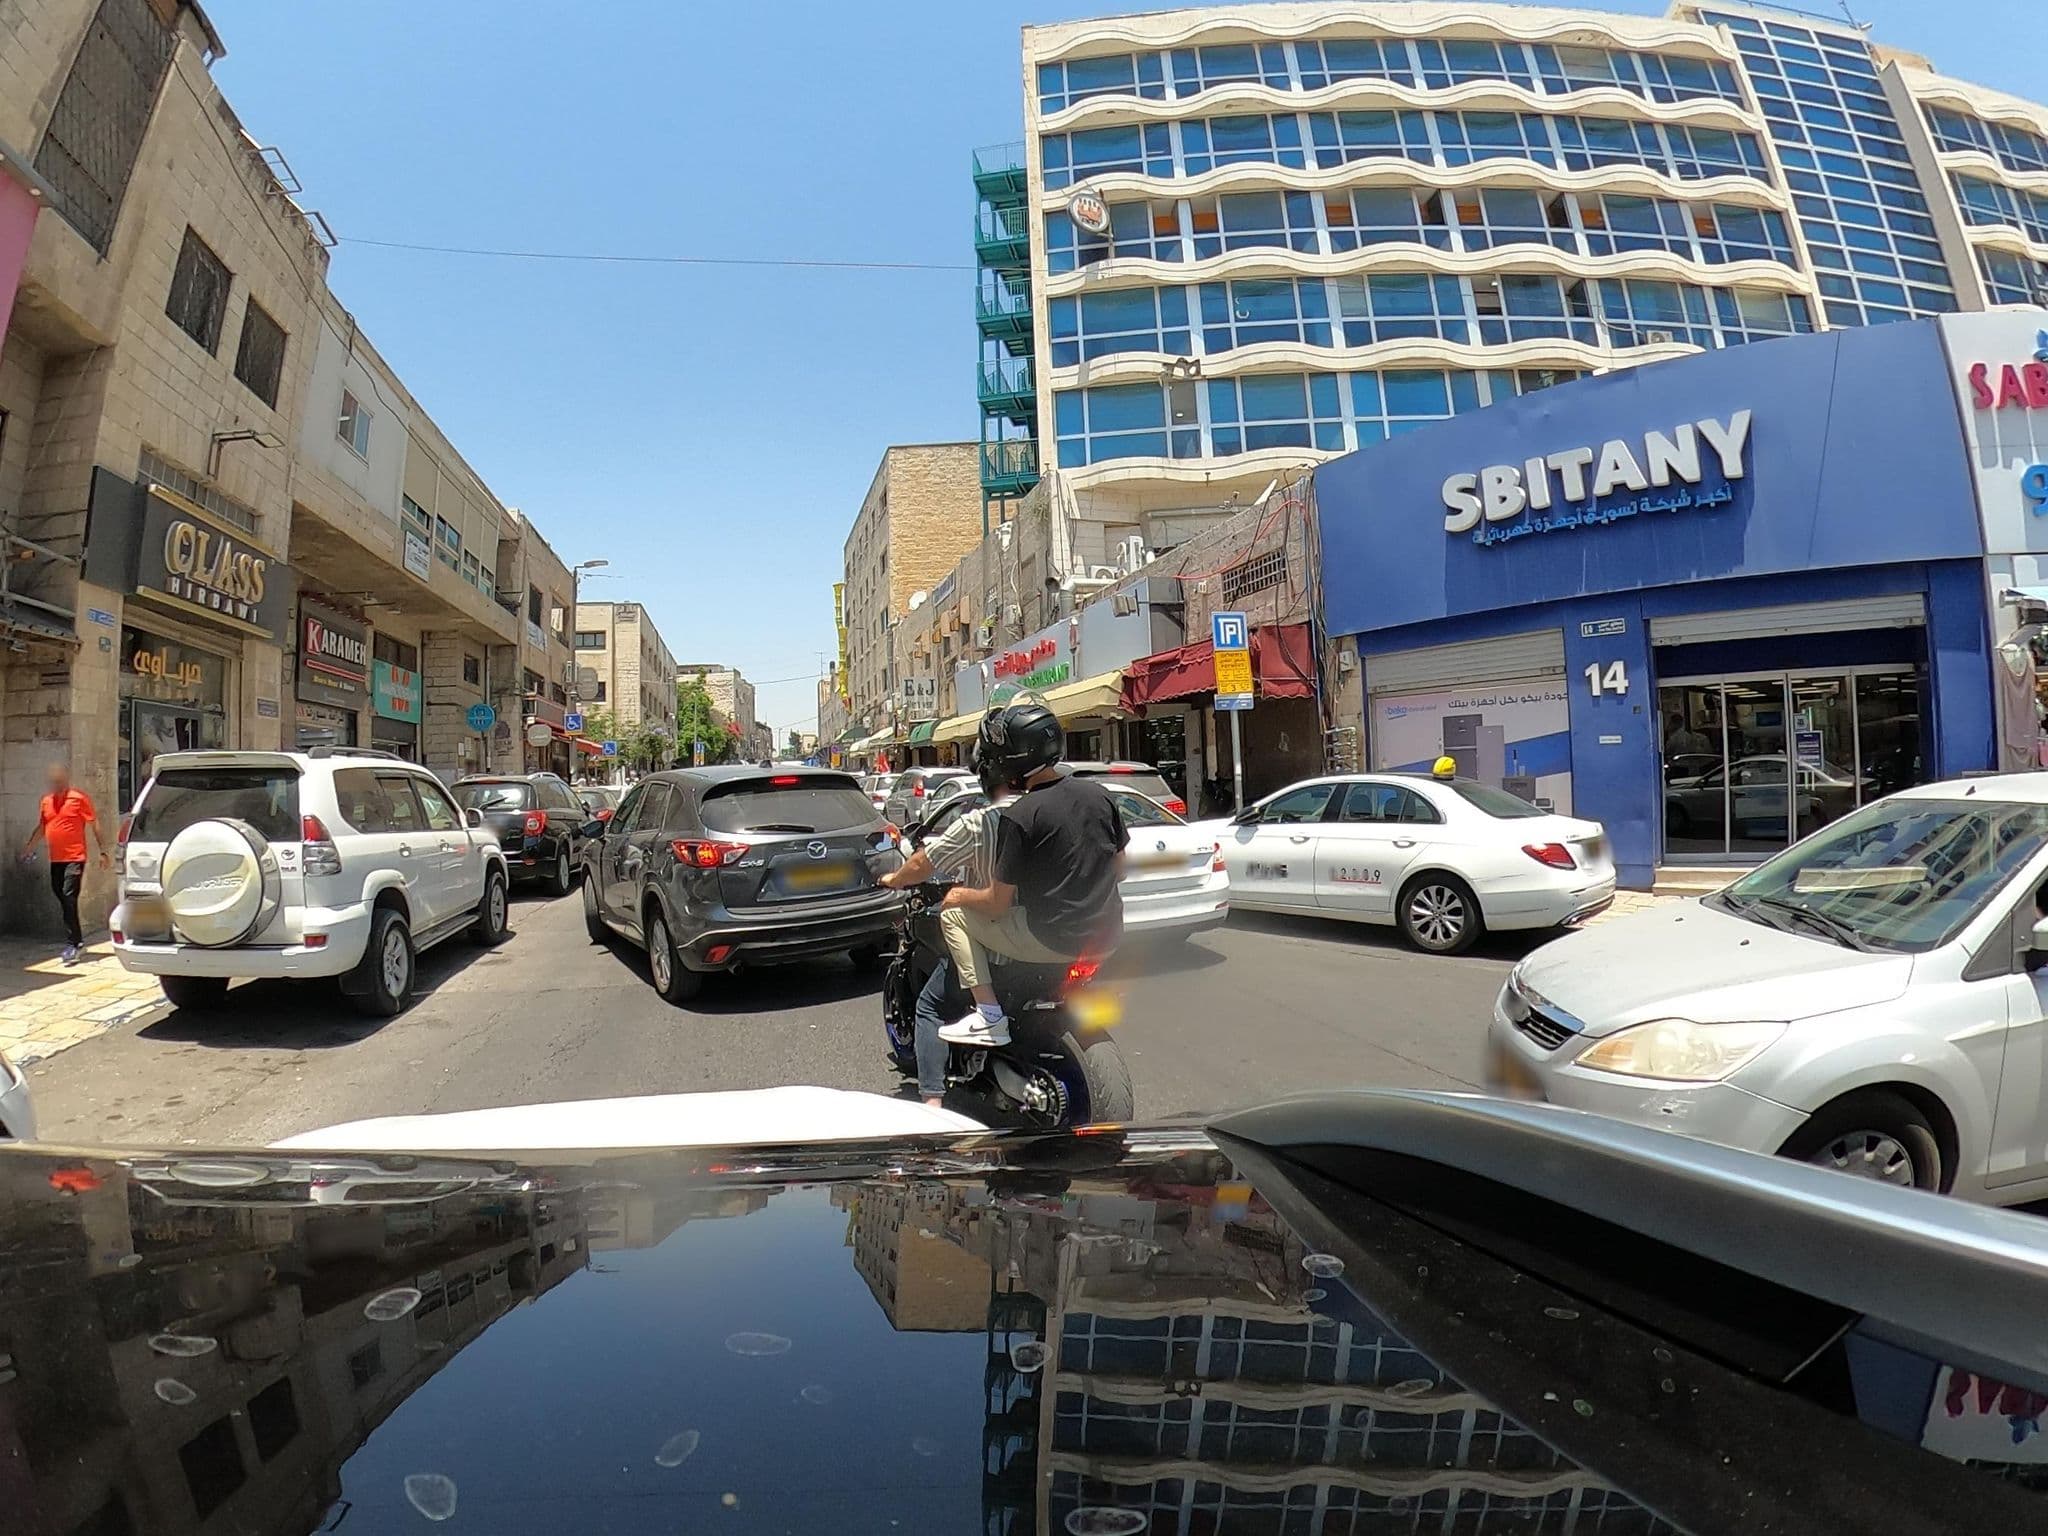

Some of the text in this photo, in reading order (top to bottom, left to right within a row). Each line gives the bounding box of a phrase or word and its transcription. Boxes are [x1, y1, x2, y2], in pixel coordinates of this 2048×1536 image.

[1441, 409, 1752, 533] SBITANY
[1472, 482, 1733, 546] أكبر شبكة تسويق أجهزة كهربائية
[165, 521, 265, 605] CLASS
[168, 576, 258, 623] HIRBAWI
[307, 617, 366, 666] KARAMEH
[904, 679, 915, 696] E
[926, 679, 936, 696] J
[1584, 660, 1629, 697] 14
